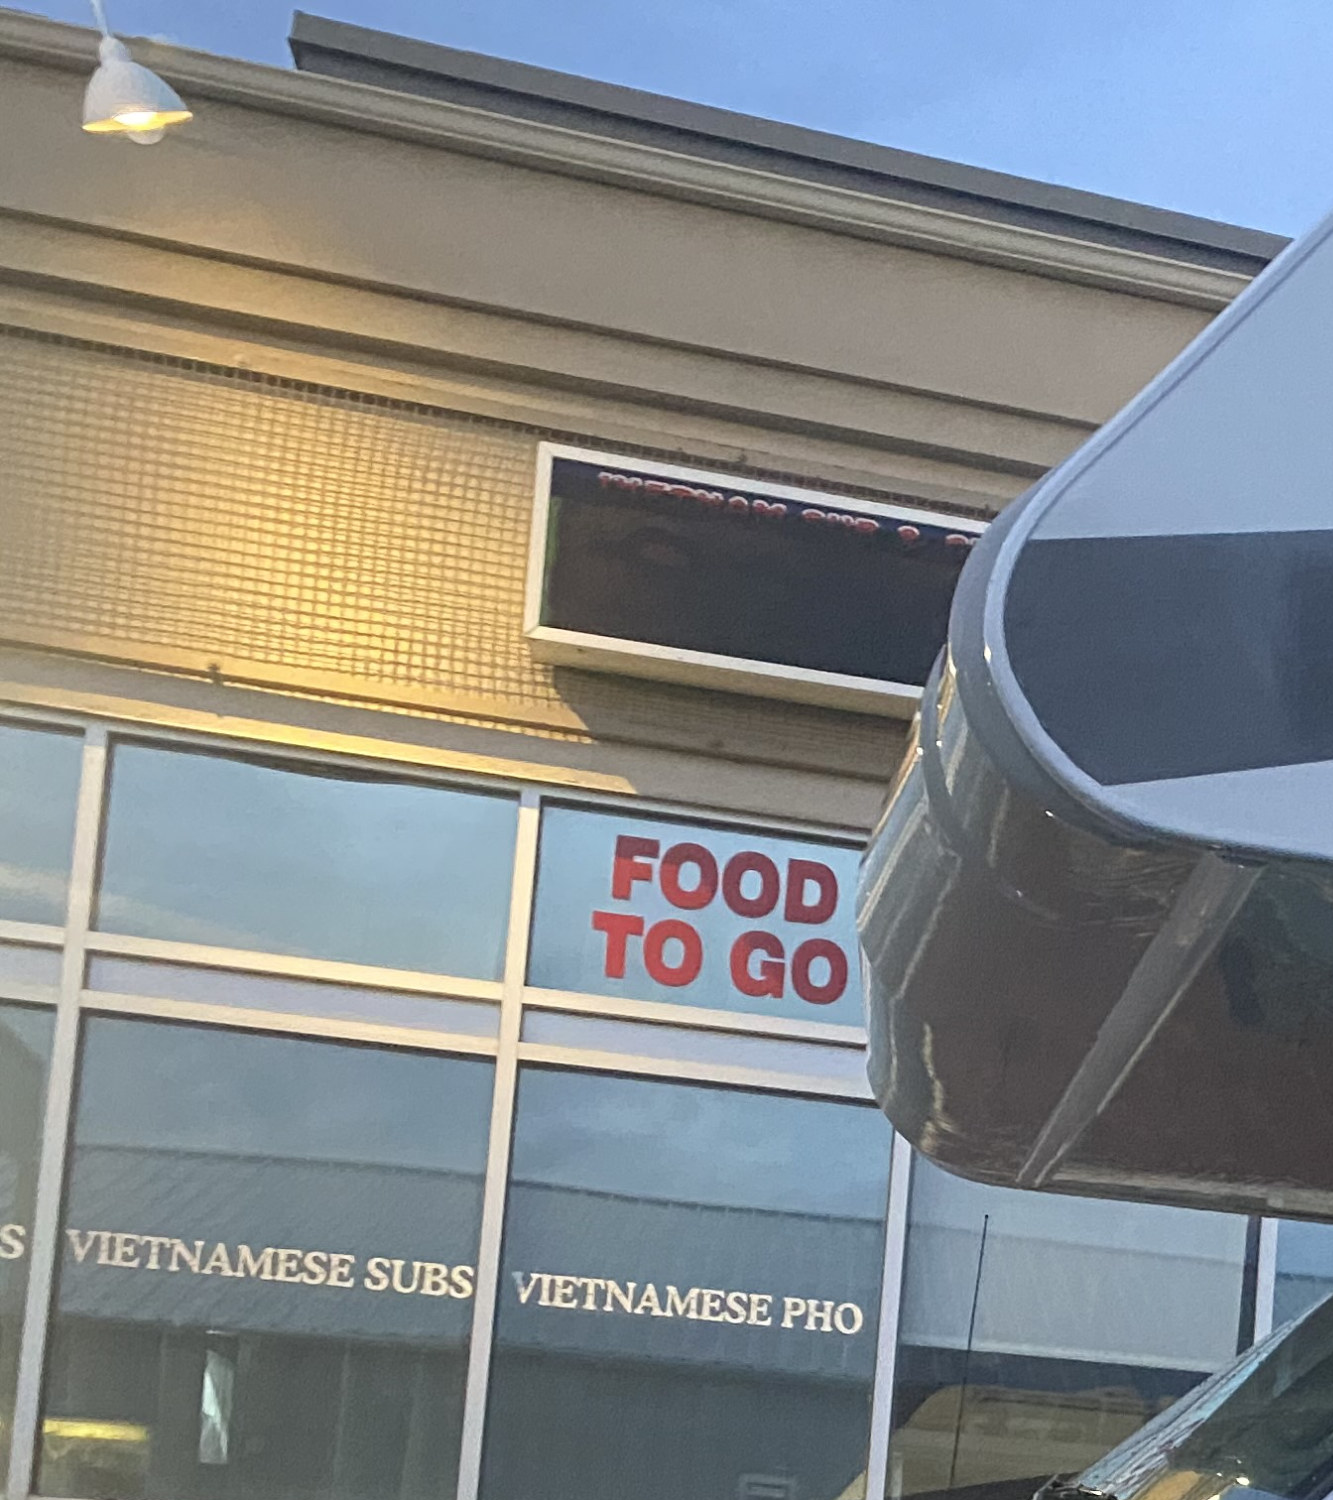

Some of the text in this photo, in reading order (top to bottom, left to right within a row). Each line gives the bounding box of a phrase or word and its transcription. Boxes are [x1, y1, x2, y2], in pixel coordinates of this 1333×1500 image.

[612, 835, 838, 925] FOOD
[592, 911, 849, 1005] TO GO
[66, 1228, 475, 1299] VIETNAMESE SUBS
[512, 1271, 864, 1335] VIETNAMESE PHO
